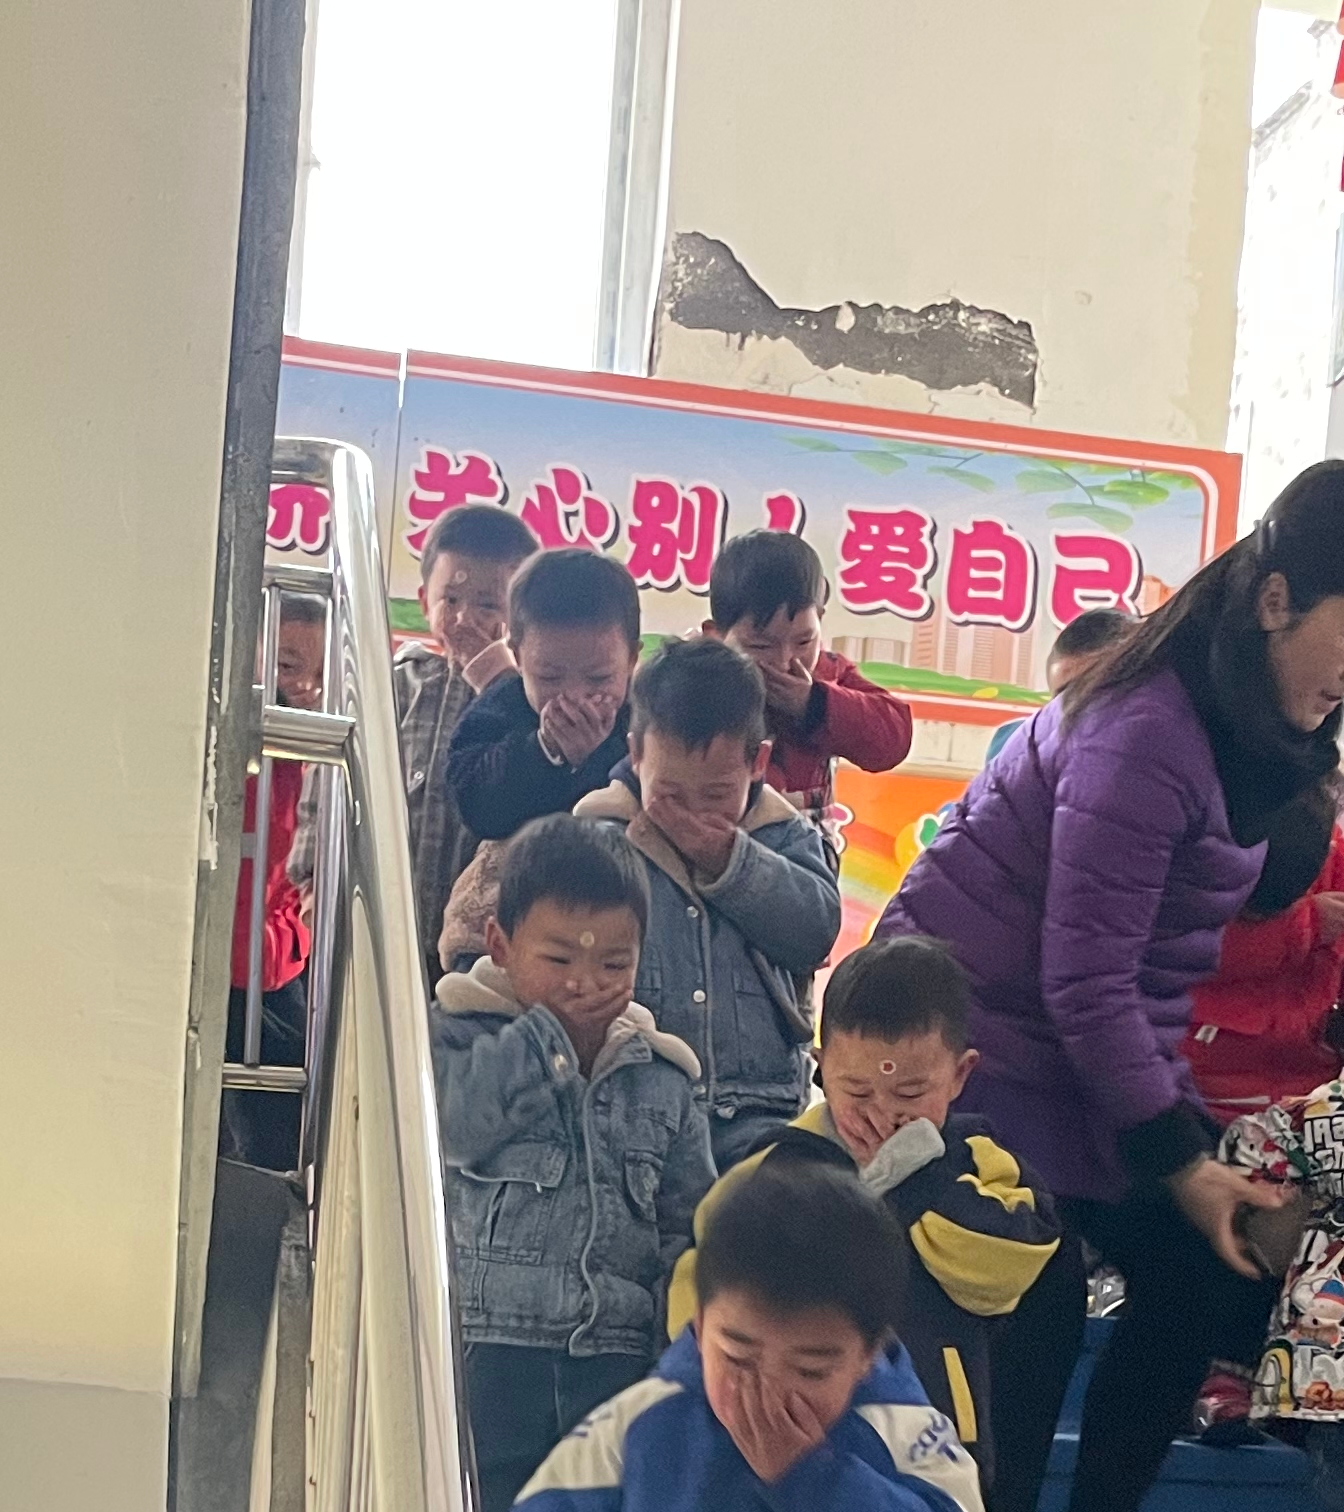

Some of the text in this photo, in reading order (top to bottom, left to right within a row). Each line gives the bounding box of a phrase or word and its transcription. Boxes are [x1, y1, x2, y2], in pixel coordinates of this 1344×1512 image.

[405, 446, 1138, 630] 关心别爱自己
